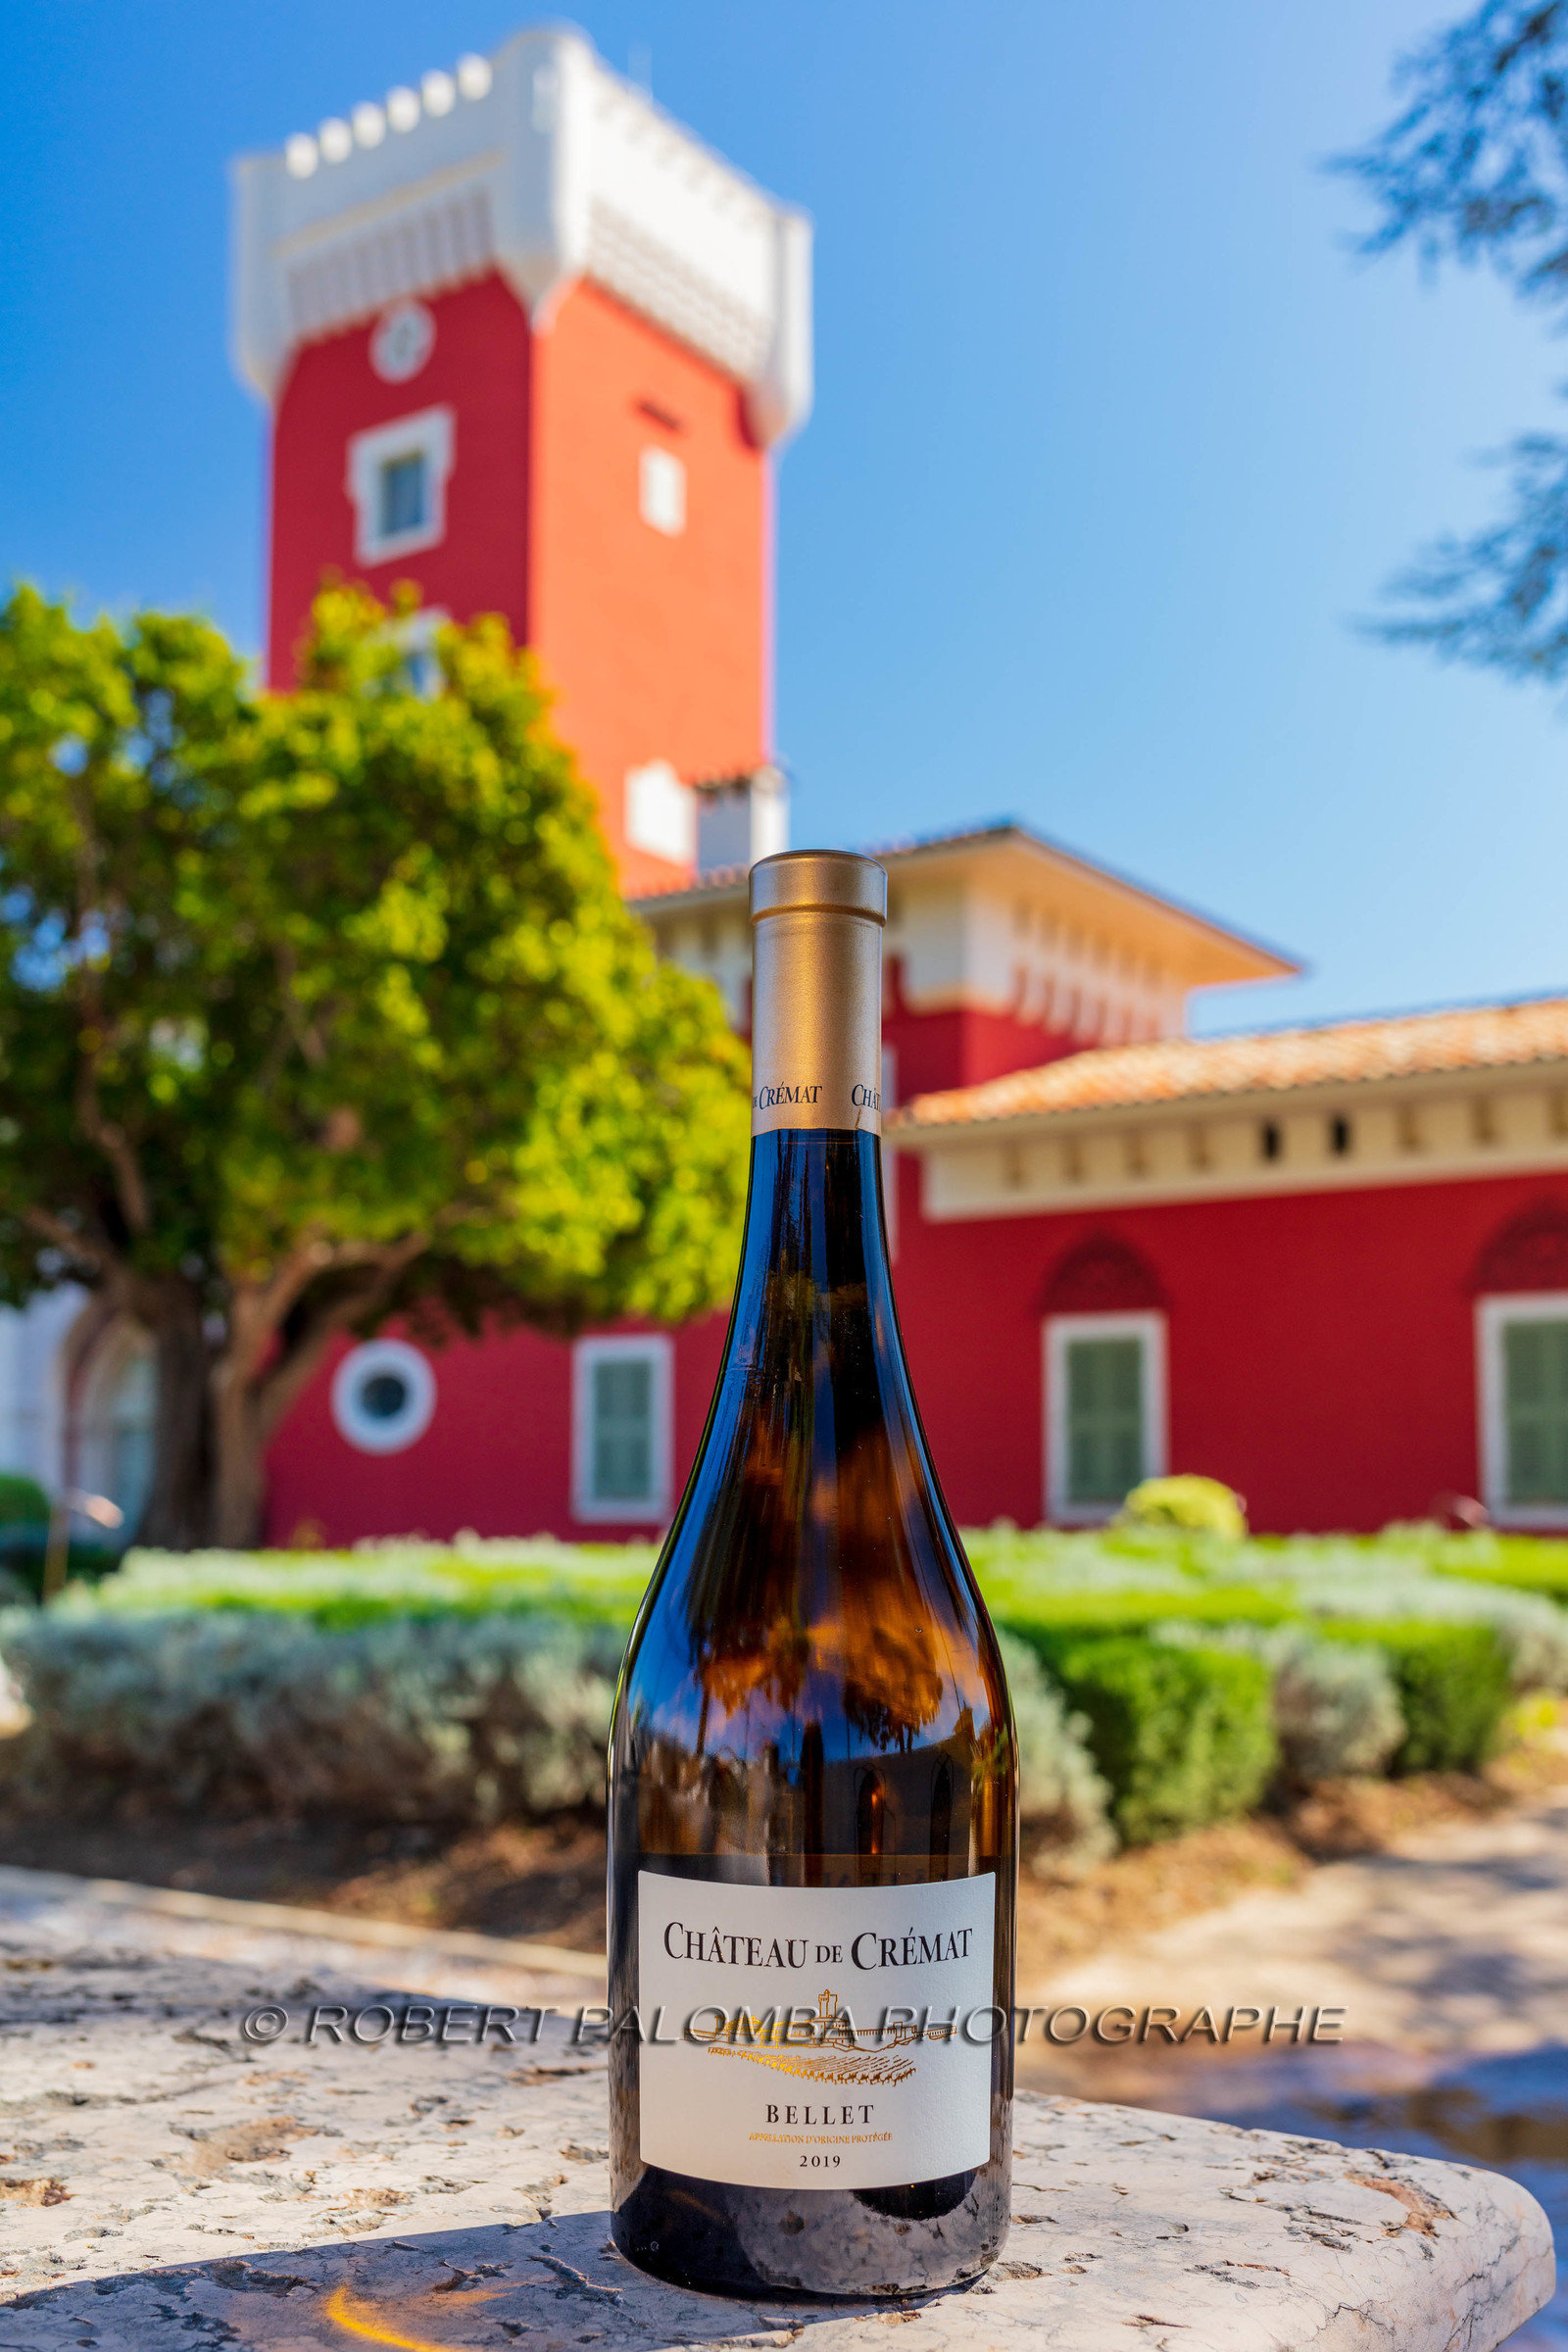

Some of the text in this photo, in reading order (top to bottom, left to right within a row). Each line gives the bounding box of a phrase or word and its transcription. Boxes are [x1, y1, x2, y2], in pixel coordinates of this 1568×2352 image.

[759, 1081, 823, 1110] CRÉMAT
[663, 1921, 974, 1971] CHÂTEAU DE CRÉMAT
[764, 2103, 875, 2126] BELLET
[748, 2131, 894, 2145] APPELLATION D'ORIGINE PROTÉGÉE
[799, 2155, 841, 2168] 2019
